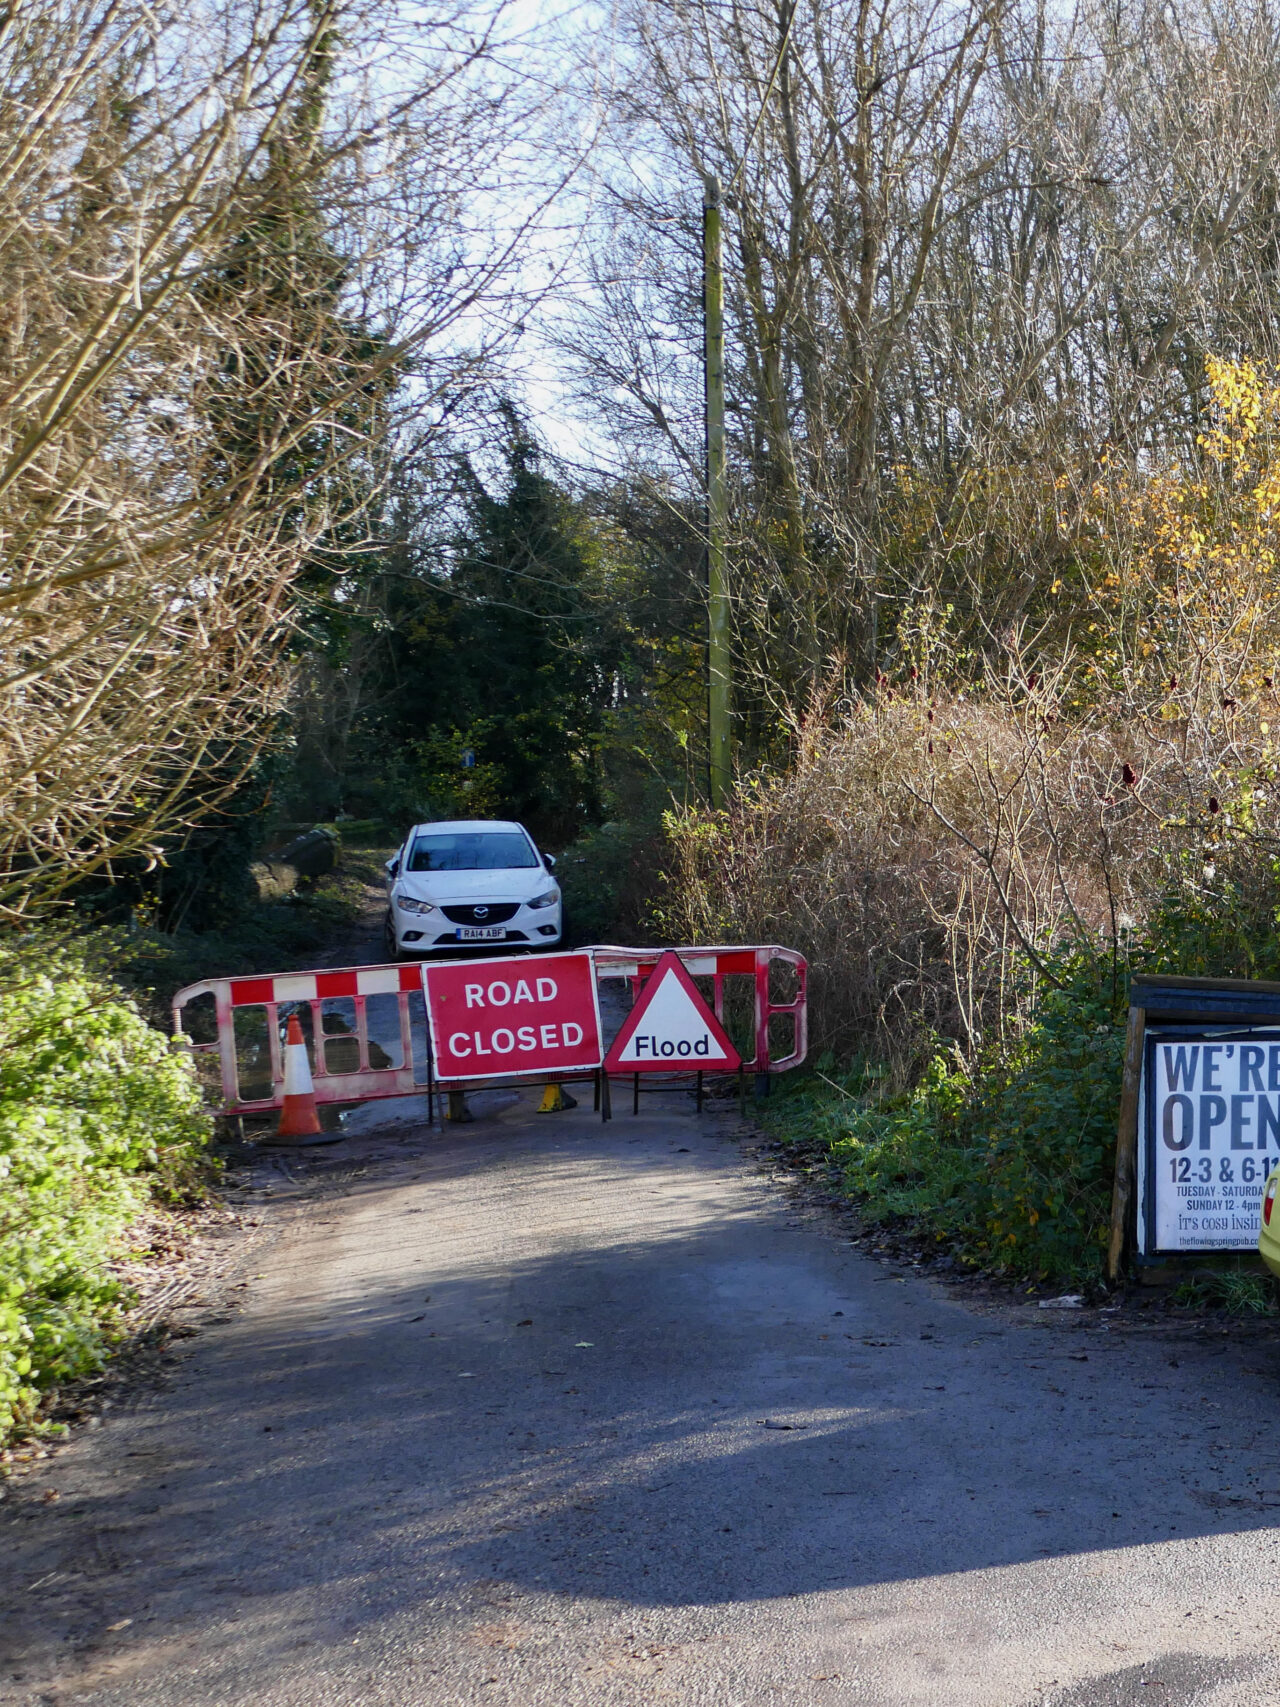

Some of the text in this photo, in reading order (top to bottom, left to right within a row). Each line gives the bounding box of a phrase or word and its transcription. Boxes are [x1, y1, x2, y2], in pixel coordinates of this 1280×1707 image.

[486, 929, 503, 938] ABF
[465, 977, 558, 1008] ROAD
[449, 1022, 584, 1058] CLOSED
[635, 1034, 709, 1057] Flood
[1169, 1157, 1212, 1183] 12-3
[1219, 1157, 1234, 1183] &
[1177, 1186, 1216, 1197] TUESDAY
[1222, 1186, 1264, 1197] SATURDA
[1187, 1200, 1222, 1210] SUNDAY
[1225, 1200, 1235, 1210] 12
[1241, 1200, 1261, 1212] 4pm
[1179, 1236, 1258, 1247] theflowingspringpub.co
